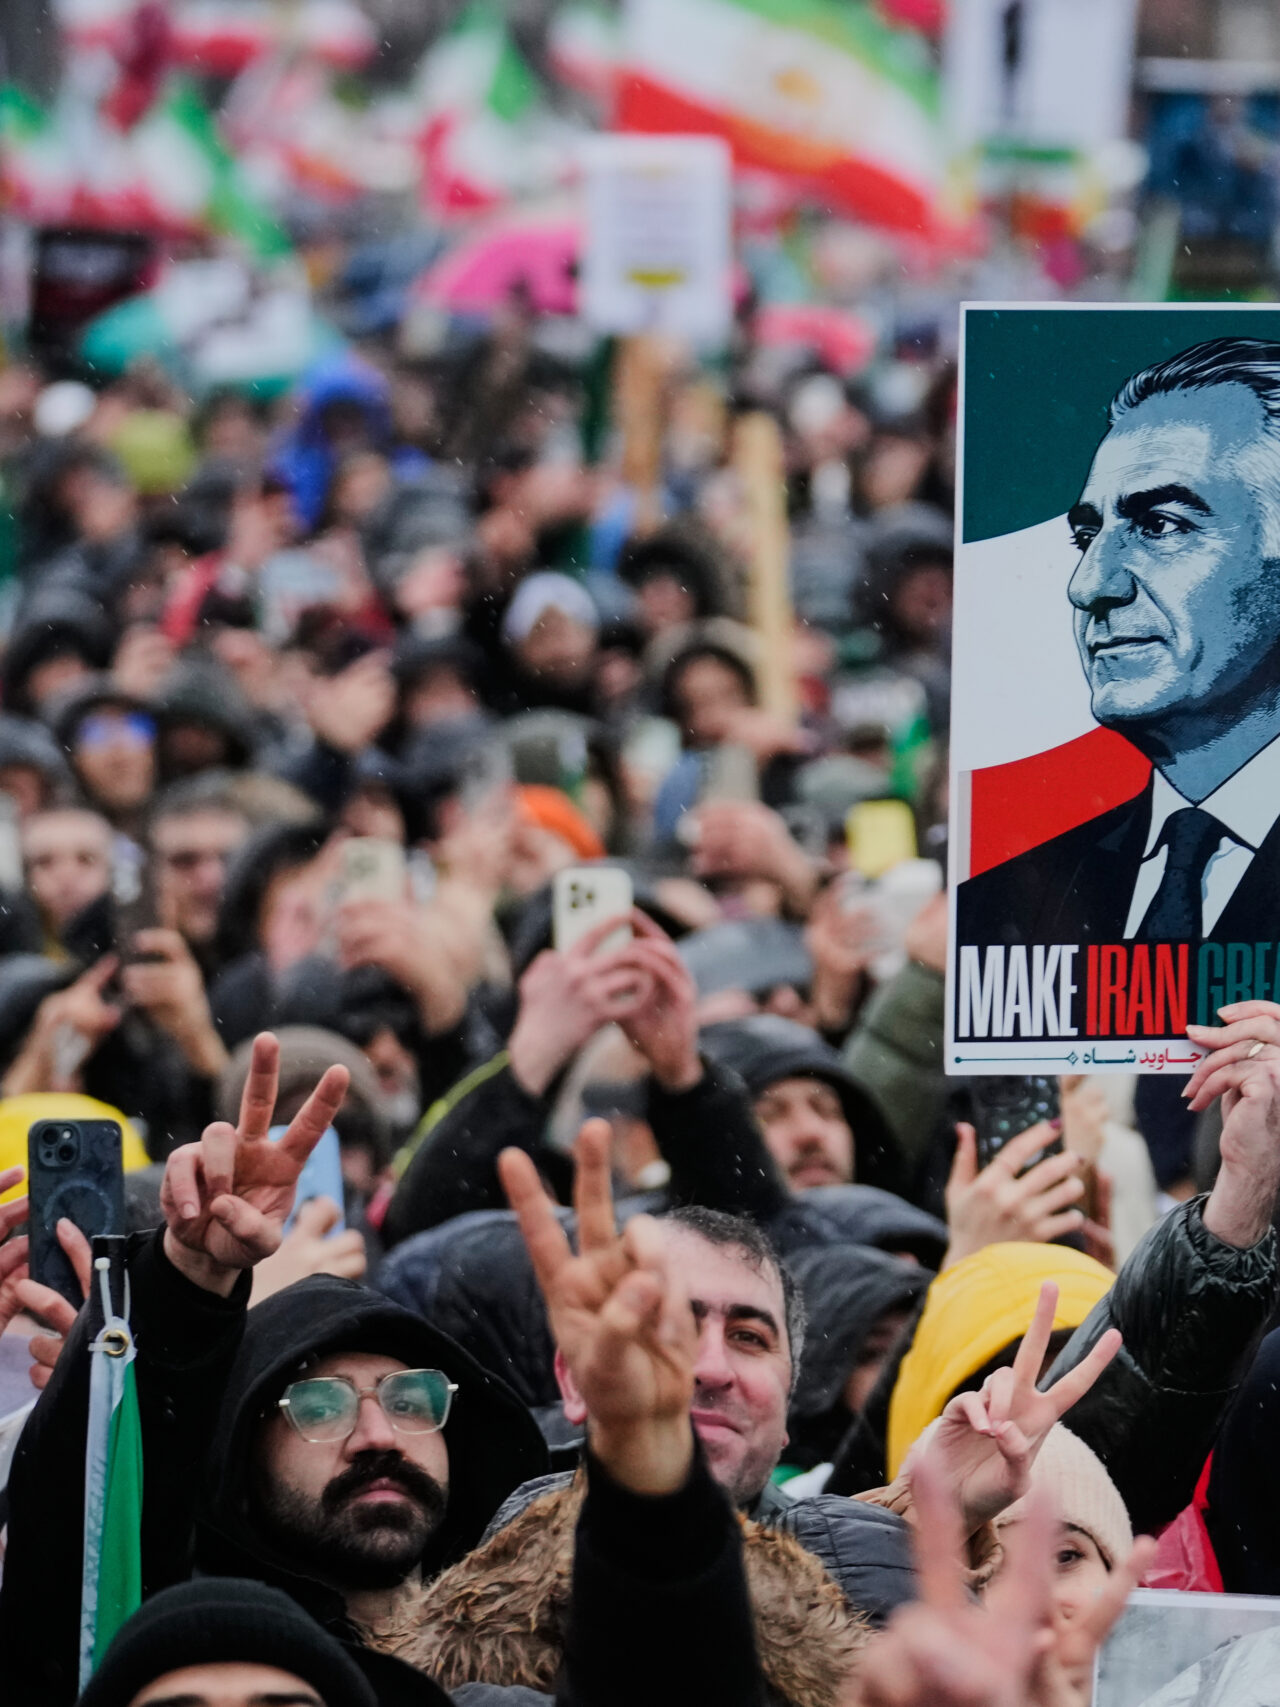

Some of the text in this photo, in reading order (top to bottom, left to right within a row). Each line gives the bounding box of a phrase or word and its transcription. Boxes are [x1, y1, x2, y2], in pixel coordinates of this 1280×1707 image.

[959, 945, 1079, 1037] MAKE
[1086, 943, 1189, 1035] IRAN
[1083, 1046, 1203, 1071] جاوید شاه
